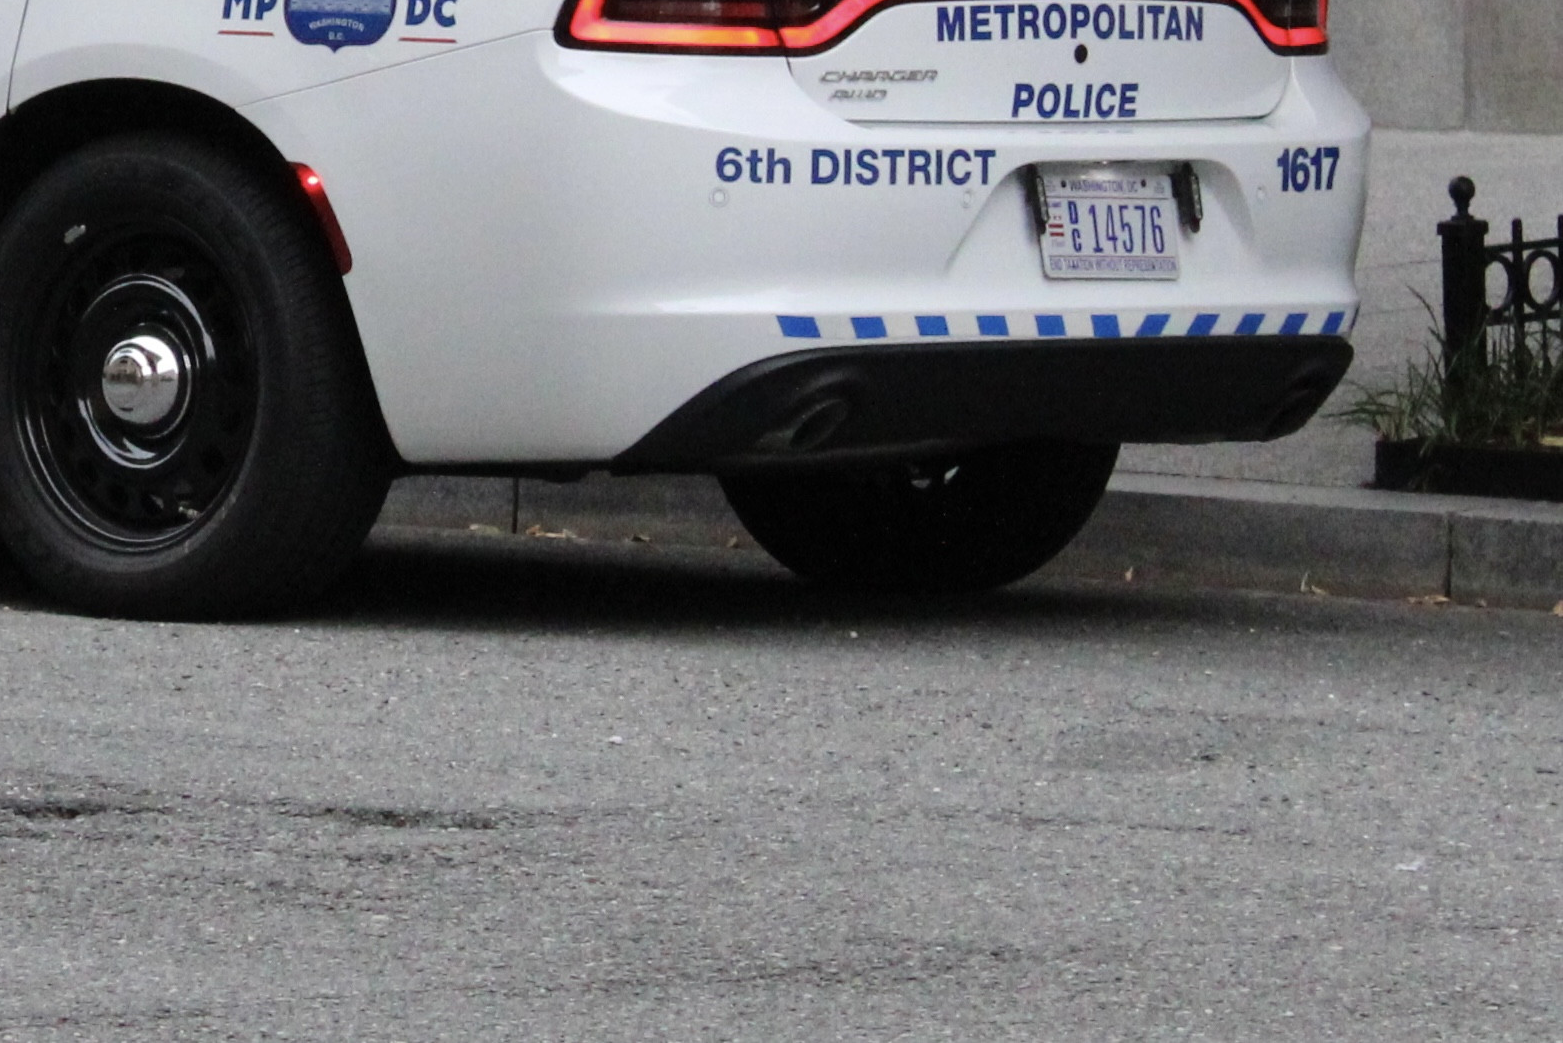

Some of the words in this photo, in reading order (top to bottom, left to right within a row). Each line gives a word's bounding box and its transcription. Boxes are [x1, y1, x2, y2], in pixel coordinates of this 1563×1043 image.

[308, 17, 365, 32] WASHINGTON
[937, 3, 1203, 41] METROPOLITAN
[820, 69, 938, 83] CHARGER
[1011, 83, 1139, 119] POLICE
[715, 146, 792, 184] 6th
[810, 148, 997, 186] DISTRICT
[1277, 146, 1340, 193] 1617
[1089, 204, 1165, 254] 14576
